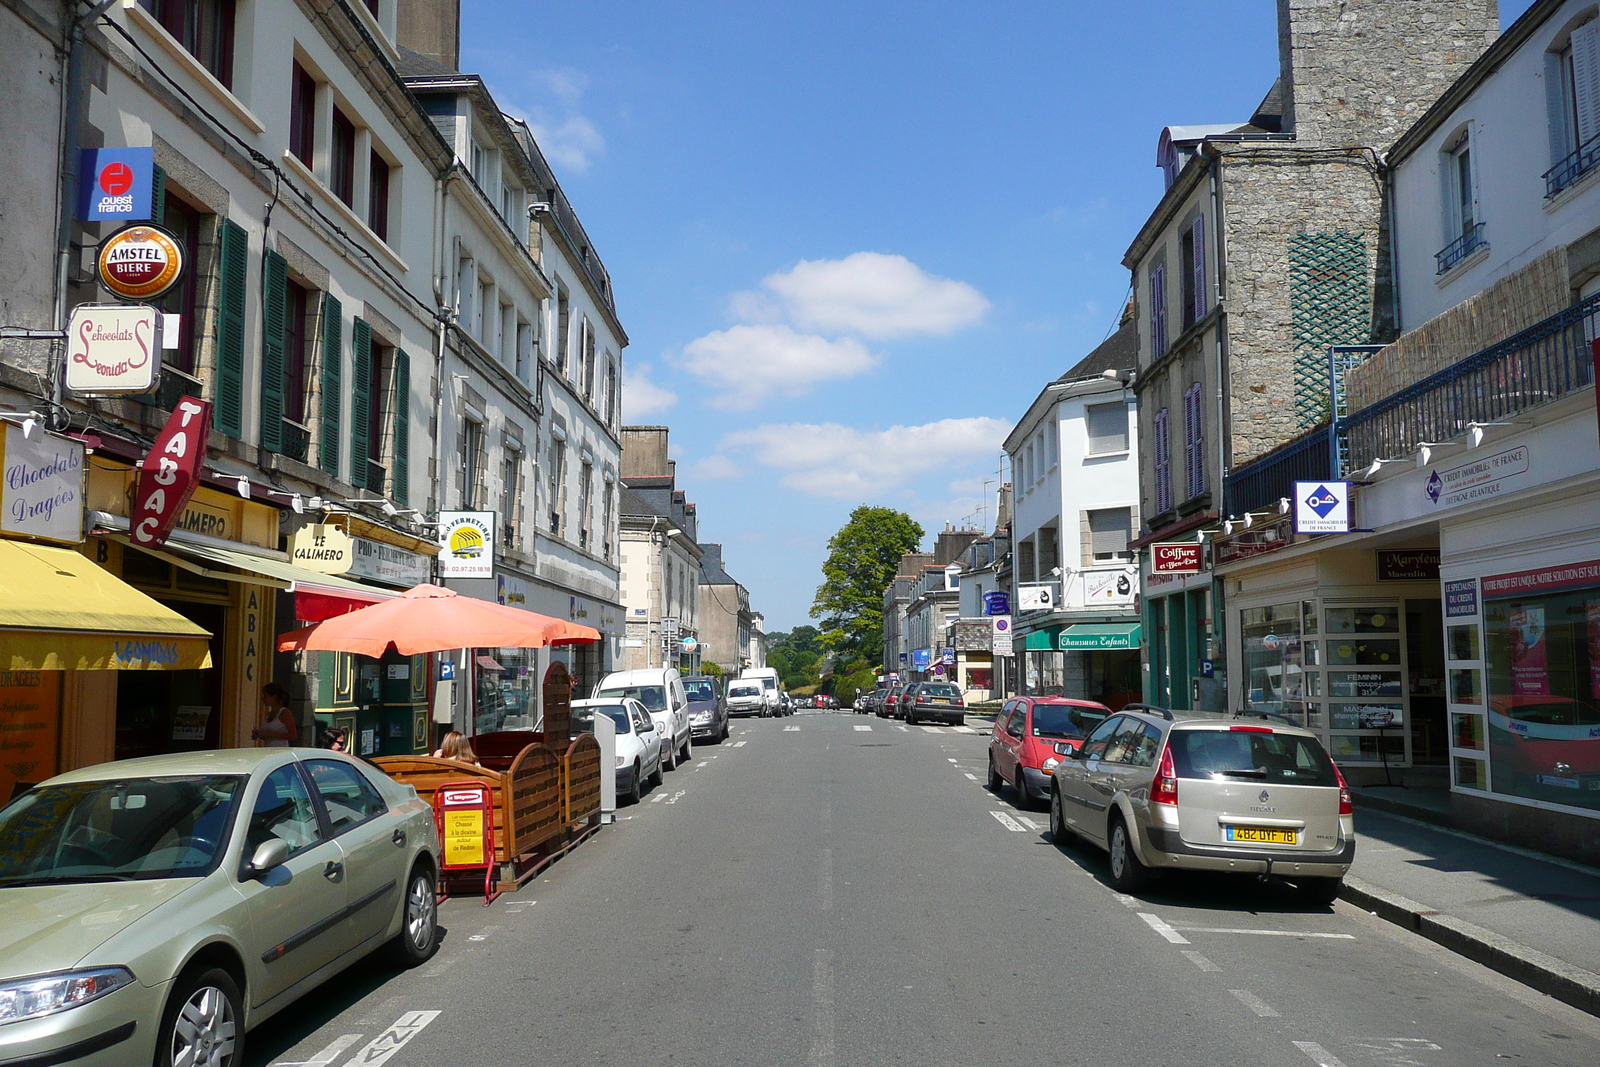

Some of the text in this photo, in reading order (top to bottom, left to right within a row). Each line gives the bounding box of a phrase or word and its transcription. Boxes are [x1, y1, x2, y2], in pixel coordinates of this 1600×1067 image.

[102, 195, 133, 205] ouest
[98, 203, 132, 213] france
[110, 248, 161, 261] AMSTEL
[116, 263, 152, 274] BIERE
[6, 448, 79, 490] Chocolats
[135, 401, 202, 543] TABAC
[12, 486, 74, 524] Dragées
[314, 535, 326, 547] LE
[294, 548, 344, 561] CALIMERO
[357, 539, 373, 557] PRO
[1160, 547, 1196, 560] Coiffure
[1387, 570, 1426, 578] Masculin
[1552, 568, 1578, 582] SOLUTION
[1578, 567, 1587, 578] EST
[1100, 636, 1128, 648] Enfants
[442, 664, 450, 677] P
[1203, 662, 1212, 673] P
[1236, 828, 1293, 842] 482 DYF 78
